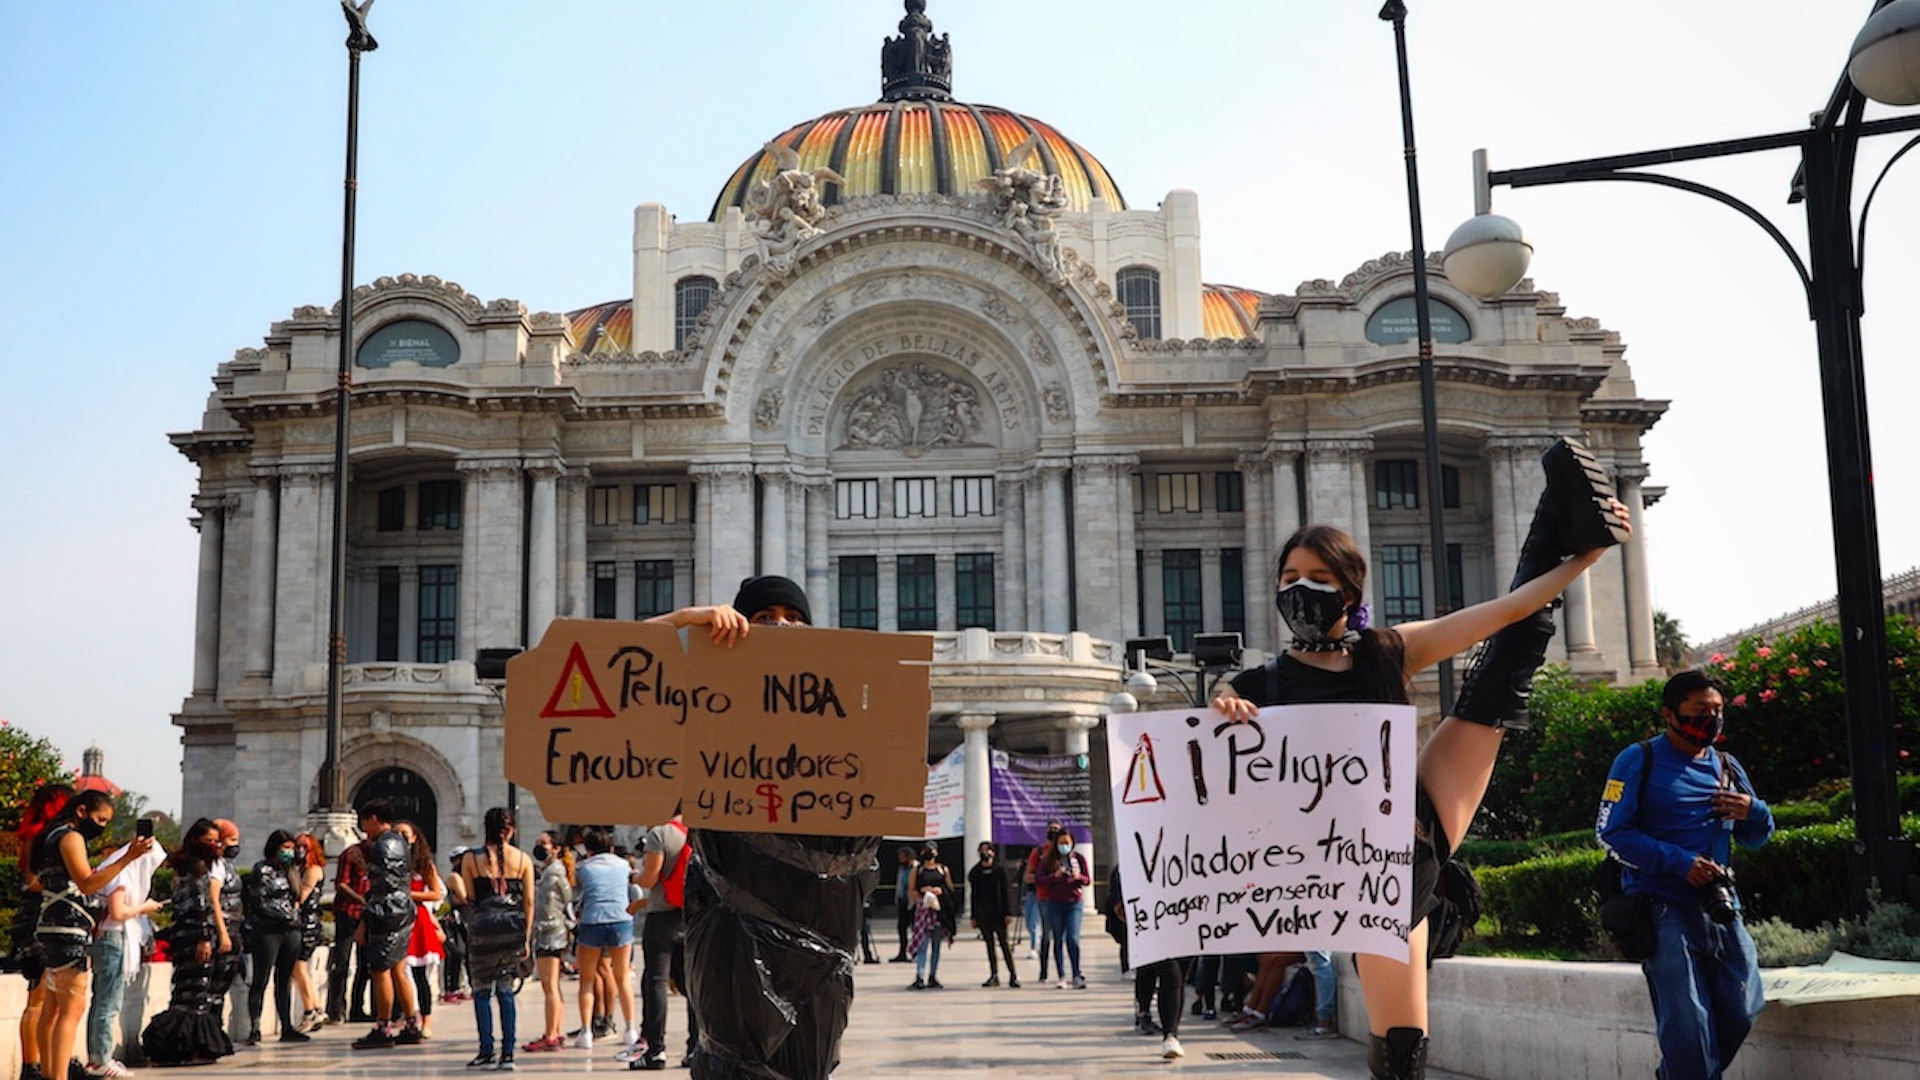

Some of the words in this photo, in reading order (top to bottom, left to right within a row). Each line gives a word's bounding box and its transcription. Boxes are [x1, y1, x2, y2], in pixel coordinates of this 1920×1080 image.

[807, 361, 856, 437] PALACIO
[860, 340, 889, 361] DE
[900, 335, 979, 367] BELLAS
[982, 371, 1021, 431] ARTES
[608, 646, 731, 725] Peligro
[763, 673, 846, 718] INBA
[546, 727, 678, 785] Encubre
[724, 790, 753, 816] les
[791, 790, 875, 823] pago
[1135, 826, 1305, 888] Violadores
[1155, 895, 1209, 930] pagan
[1217, 891, 1246, 914] por
[1252, 875, 1345, 904] enseñar
[1358, 872, 1400, 906] NO
[1199, 922, 1239, 950] por
